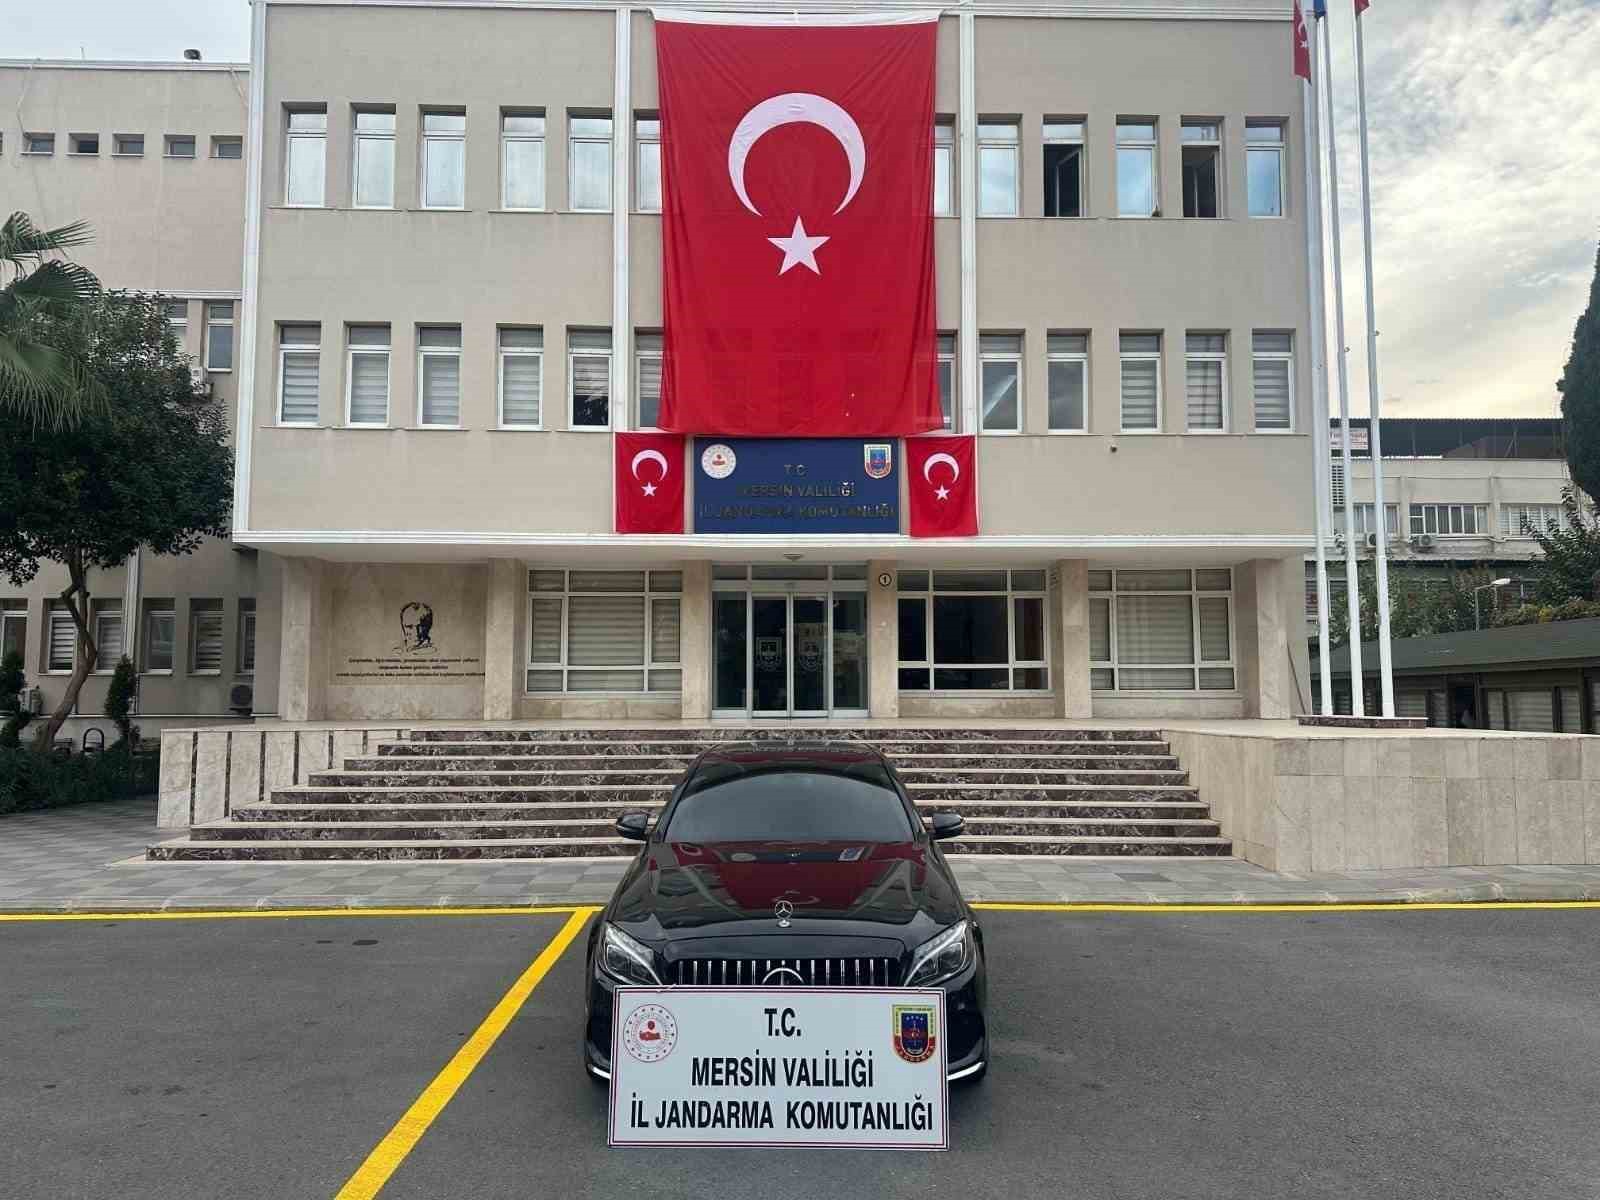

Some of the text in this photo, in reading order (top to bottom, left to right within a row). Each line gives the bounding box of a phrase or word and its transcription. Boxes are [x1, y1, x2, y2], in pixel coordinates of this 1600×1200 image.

[764, 1007, 802, 1037] T.C.
[691, 1049, 874, 1088] MERSİN VALİLİĞİ
[630, 1092, 933, 1131] İL JANDARMA KOMUTANLIĞI
